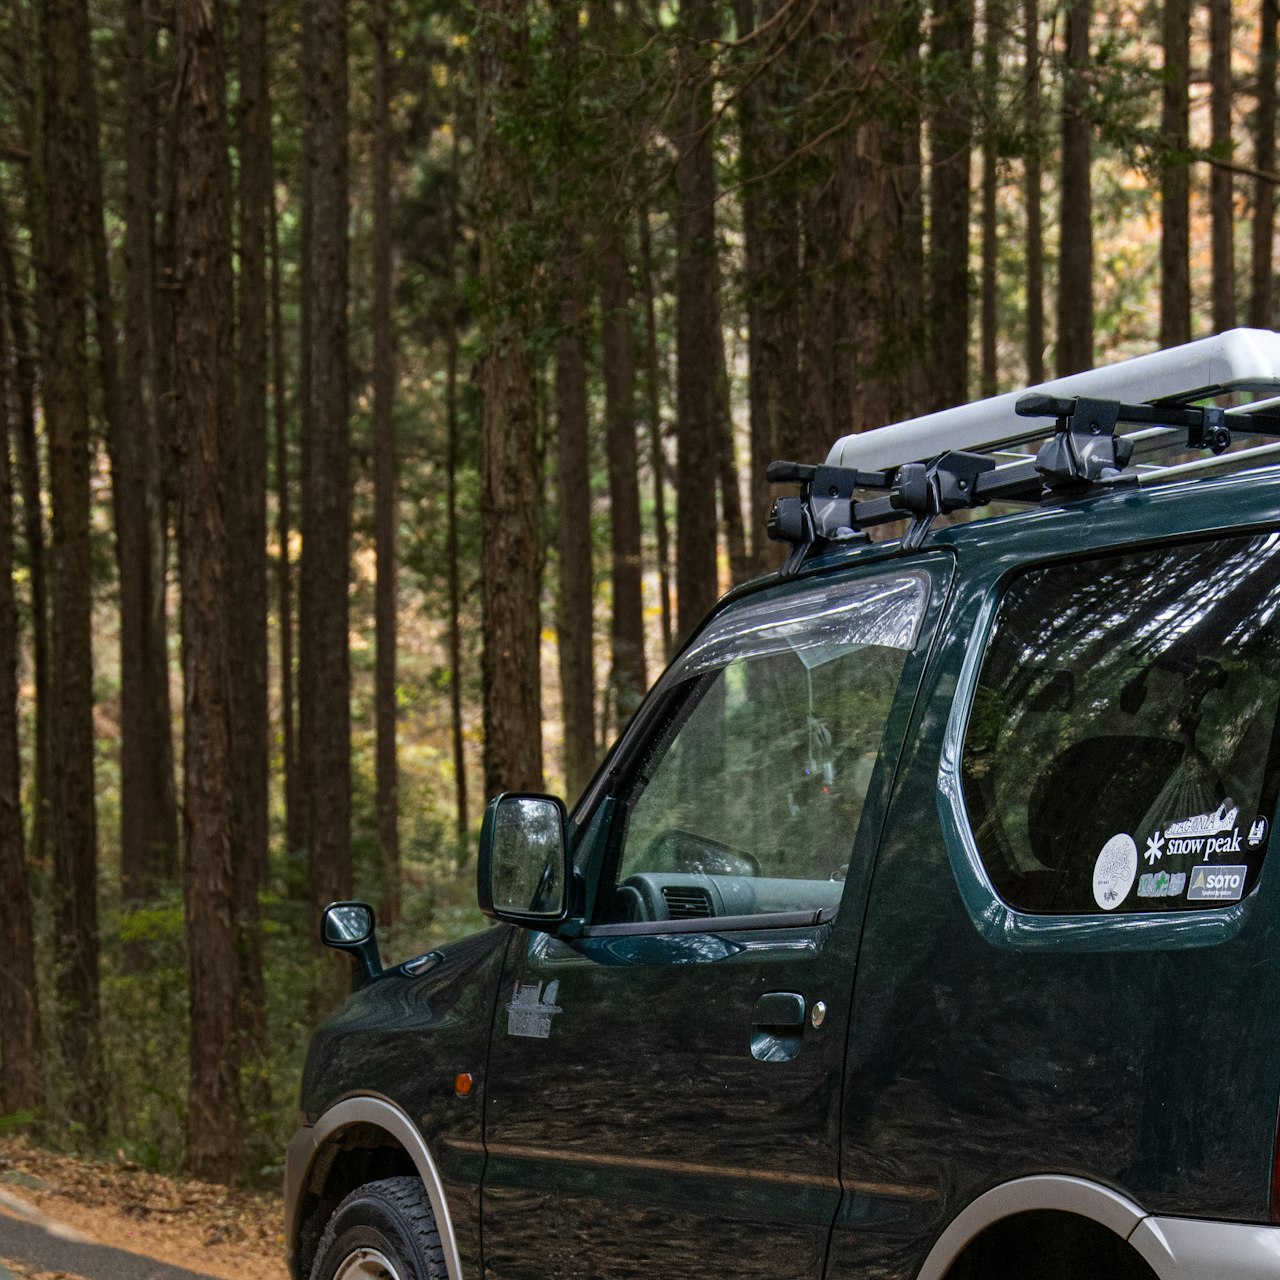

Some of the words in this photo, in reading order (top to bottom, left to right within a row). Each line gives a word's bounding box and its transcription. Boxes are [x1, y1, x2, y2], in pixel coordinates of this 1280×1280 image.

[1166, 838, 1206, 855] snow
[1202, 827, 1243, 861] peak
[1206, 874, 1240, 889] SOTO
